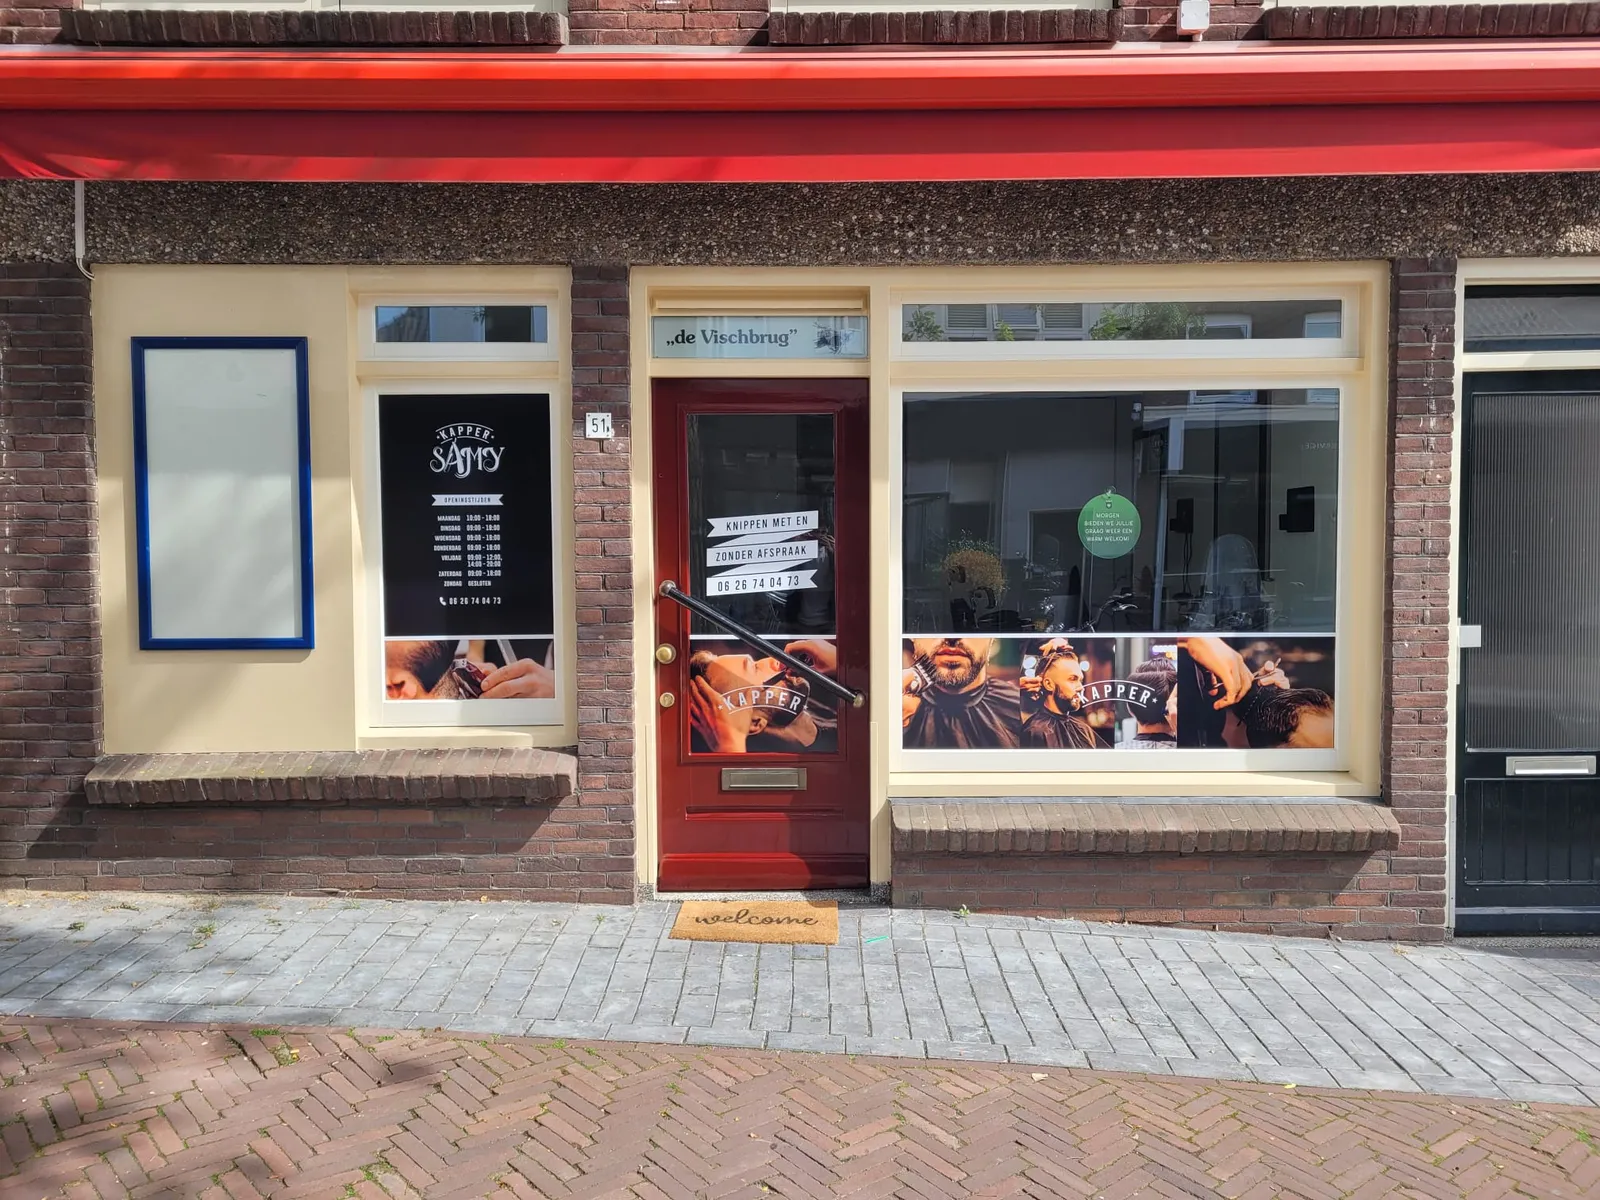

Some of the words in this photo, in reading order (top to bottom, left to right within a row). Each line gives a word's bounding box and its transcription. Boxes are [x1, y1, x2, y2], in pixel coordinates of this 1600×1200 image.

[439, 425, 490, 440] KAPPER
[592, 418, 606, 433] 51
[430, 437, 505, 479] SAMY
[726, 519, 768, 531] KNIPPEN
[772, 517, 792, 527] MET
[796, 515, 808, 525] EN
[715, 550, 753, 562] ZONDER
[757, 545, 807, 559] AFSPRAAK
[717, 581, 730, 592] 06
[735, 579, 747, 590] 26
[752, 578, 764, 588] 74
[770, 577, 782, 587] 04
[787, 575, 799, 586] 73
[723, 689, 801, 711] KAPPER
[1077, 684, 1151, 705] KAPPER
[695, 908, 819, 926] welcome
